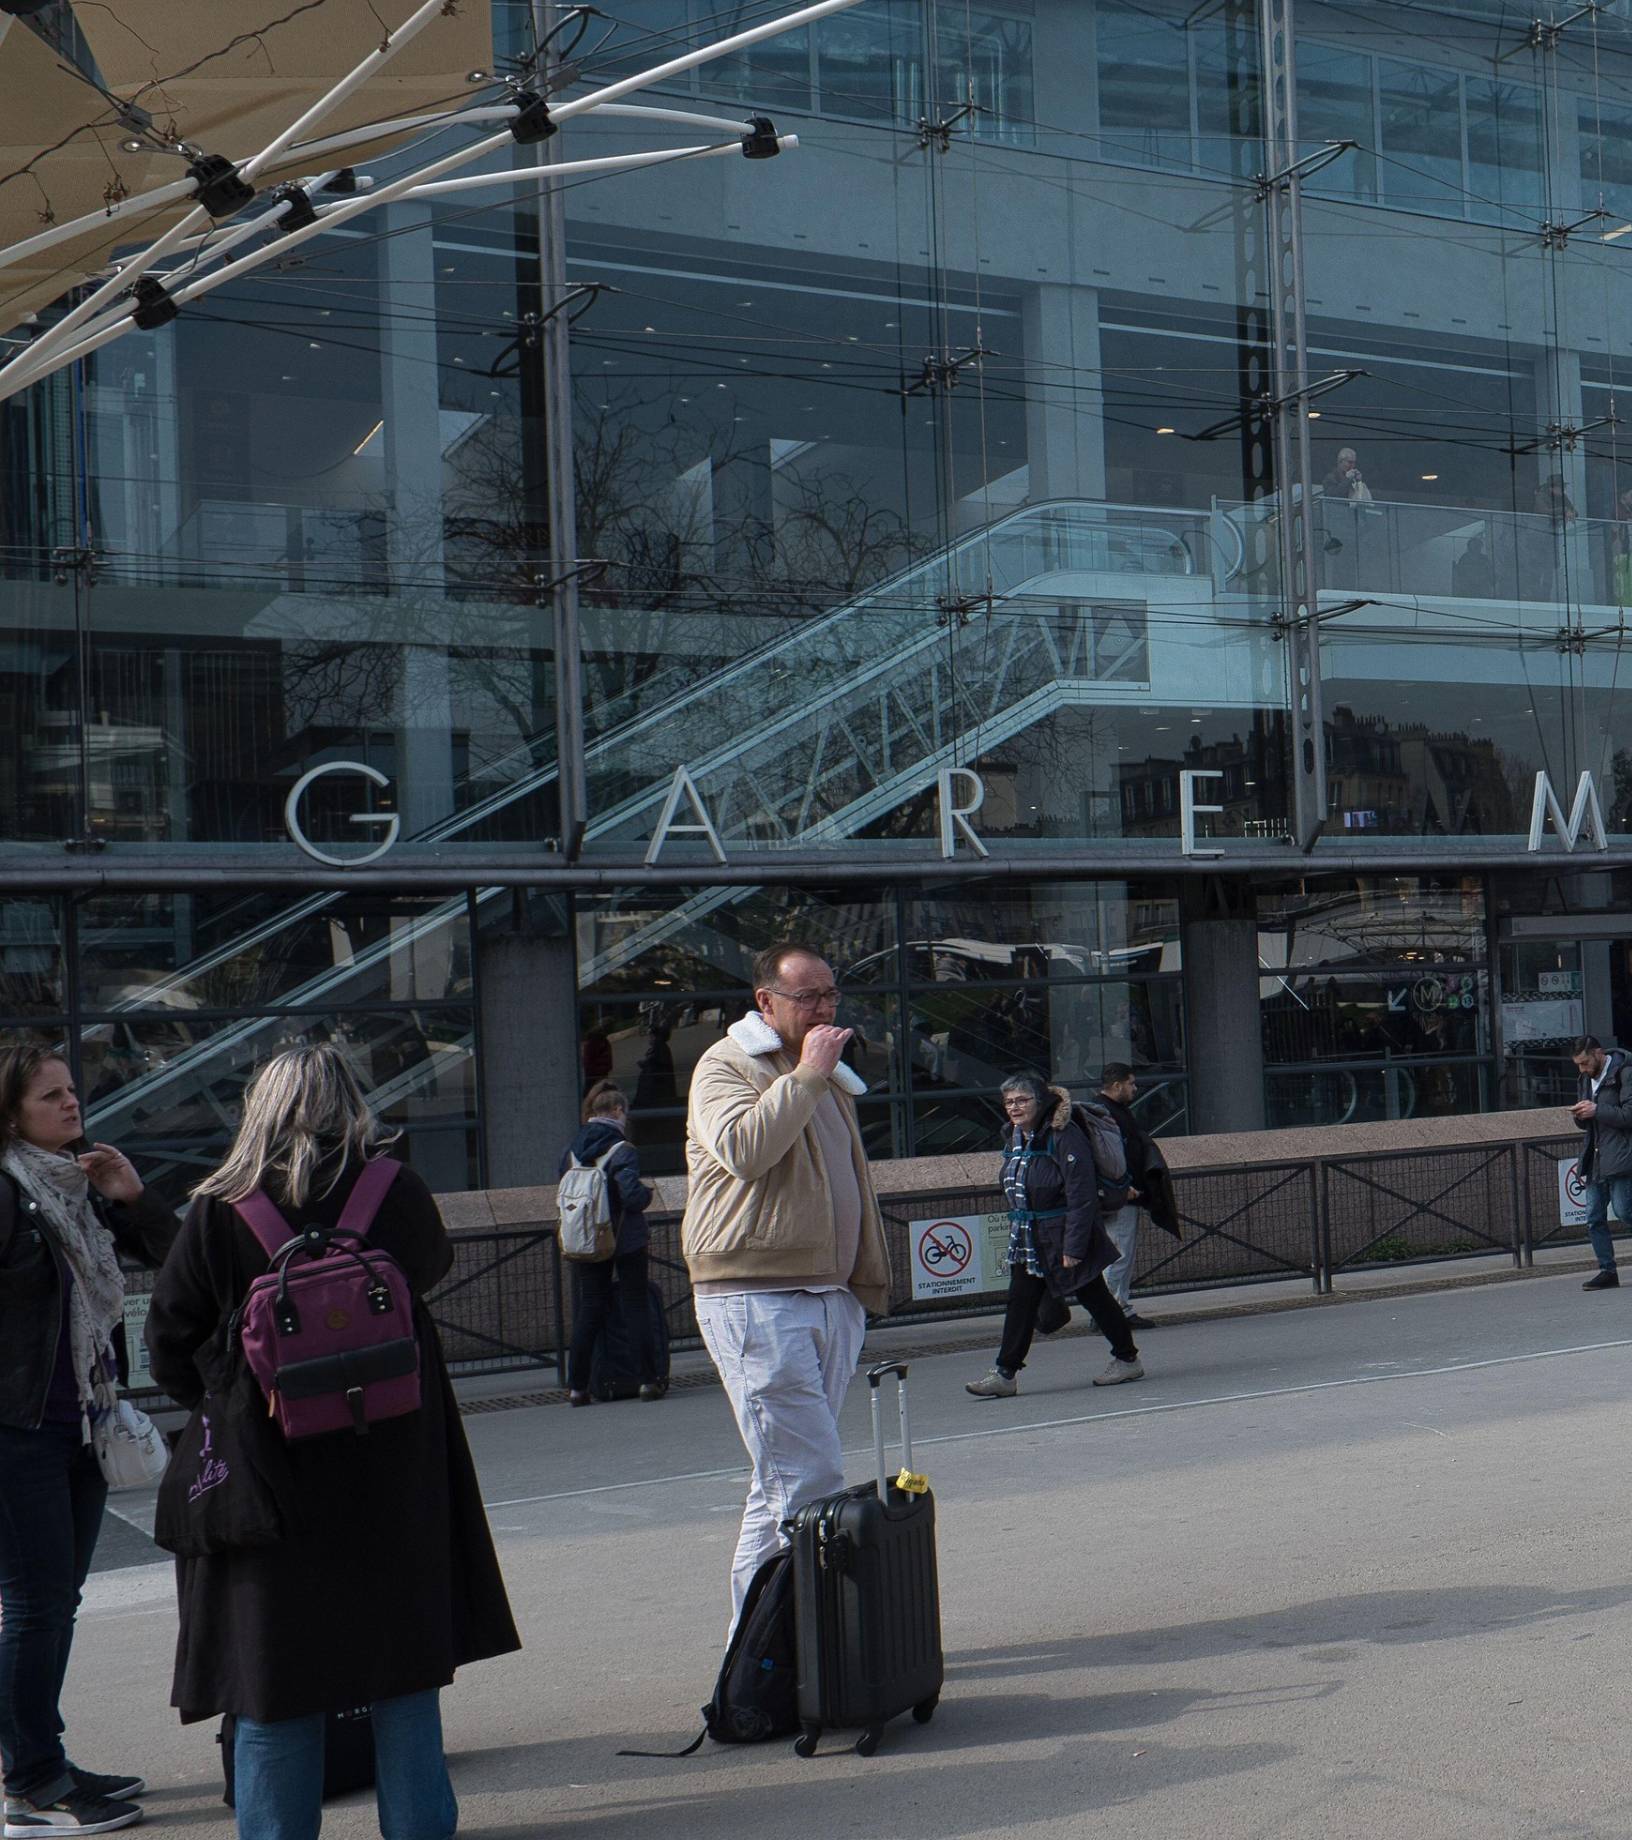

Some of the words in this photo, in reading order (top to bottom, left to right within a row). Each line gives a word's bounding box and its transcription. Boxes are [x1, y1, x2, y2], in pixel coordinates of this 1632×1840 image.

[285, 761, 1225, 867] GARE
[918, 1277, 976, 1289] STATIONNEMENT
[932, 1286, 962, 1294] INTERDIT
